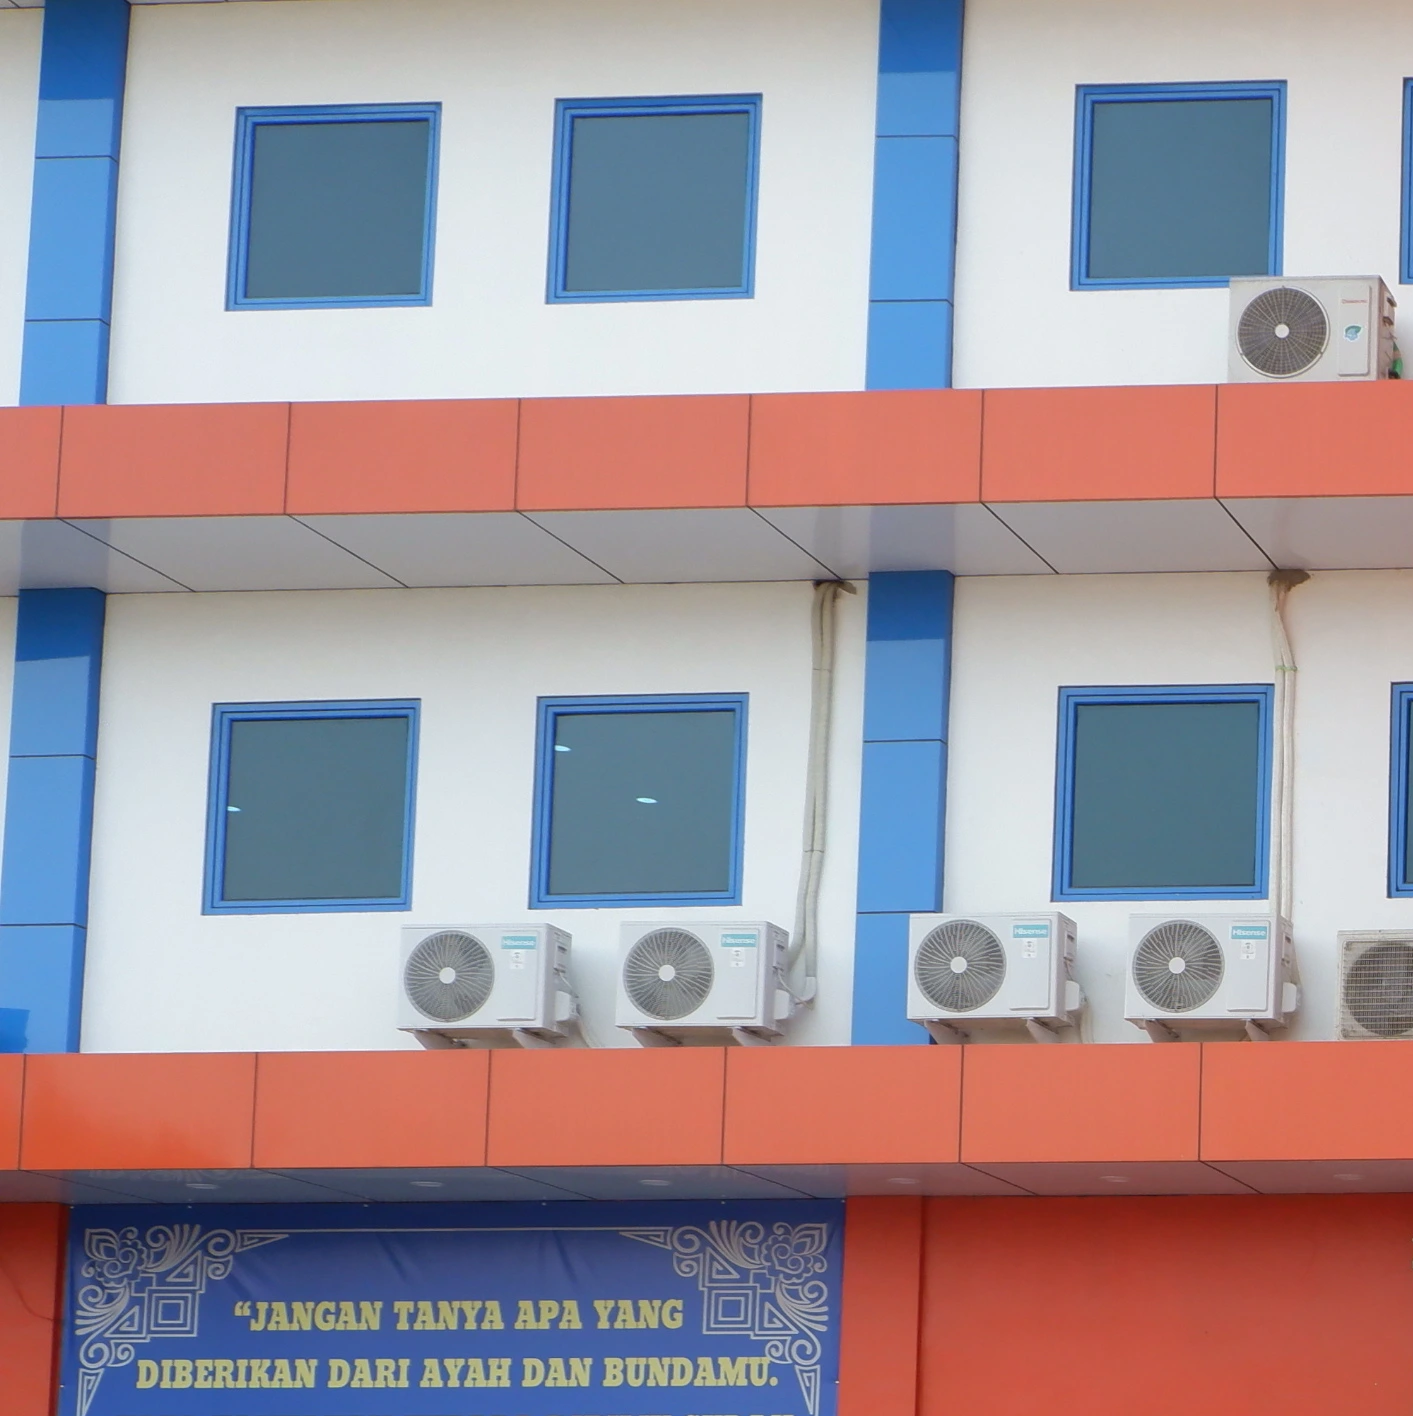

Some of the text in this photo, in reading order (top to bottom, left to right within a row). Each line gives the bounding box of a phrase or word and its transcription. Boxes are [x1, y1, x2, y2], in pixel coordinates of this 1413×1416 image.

[1013, 926, 1048, 937] Hisense
[1231, 927, 1267, 938] Hisense
[234, 1299, 683, 1331] “JANGAN TANYA APA YANG
[136, 1357, 778, 1389] DIBERIKAN DARI AYAH DAN BUNDAMU.
